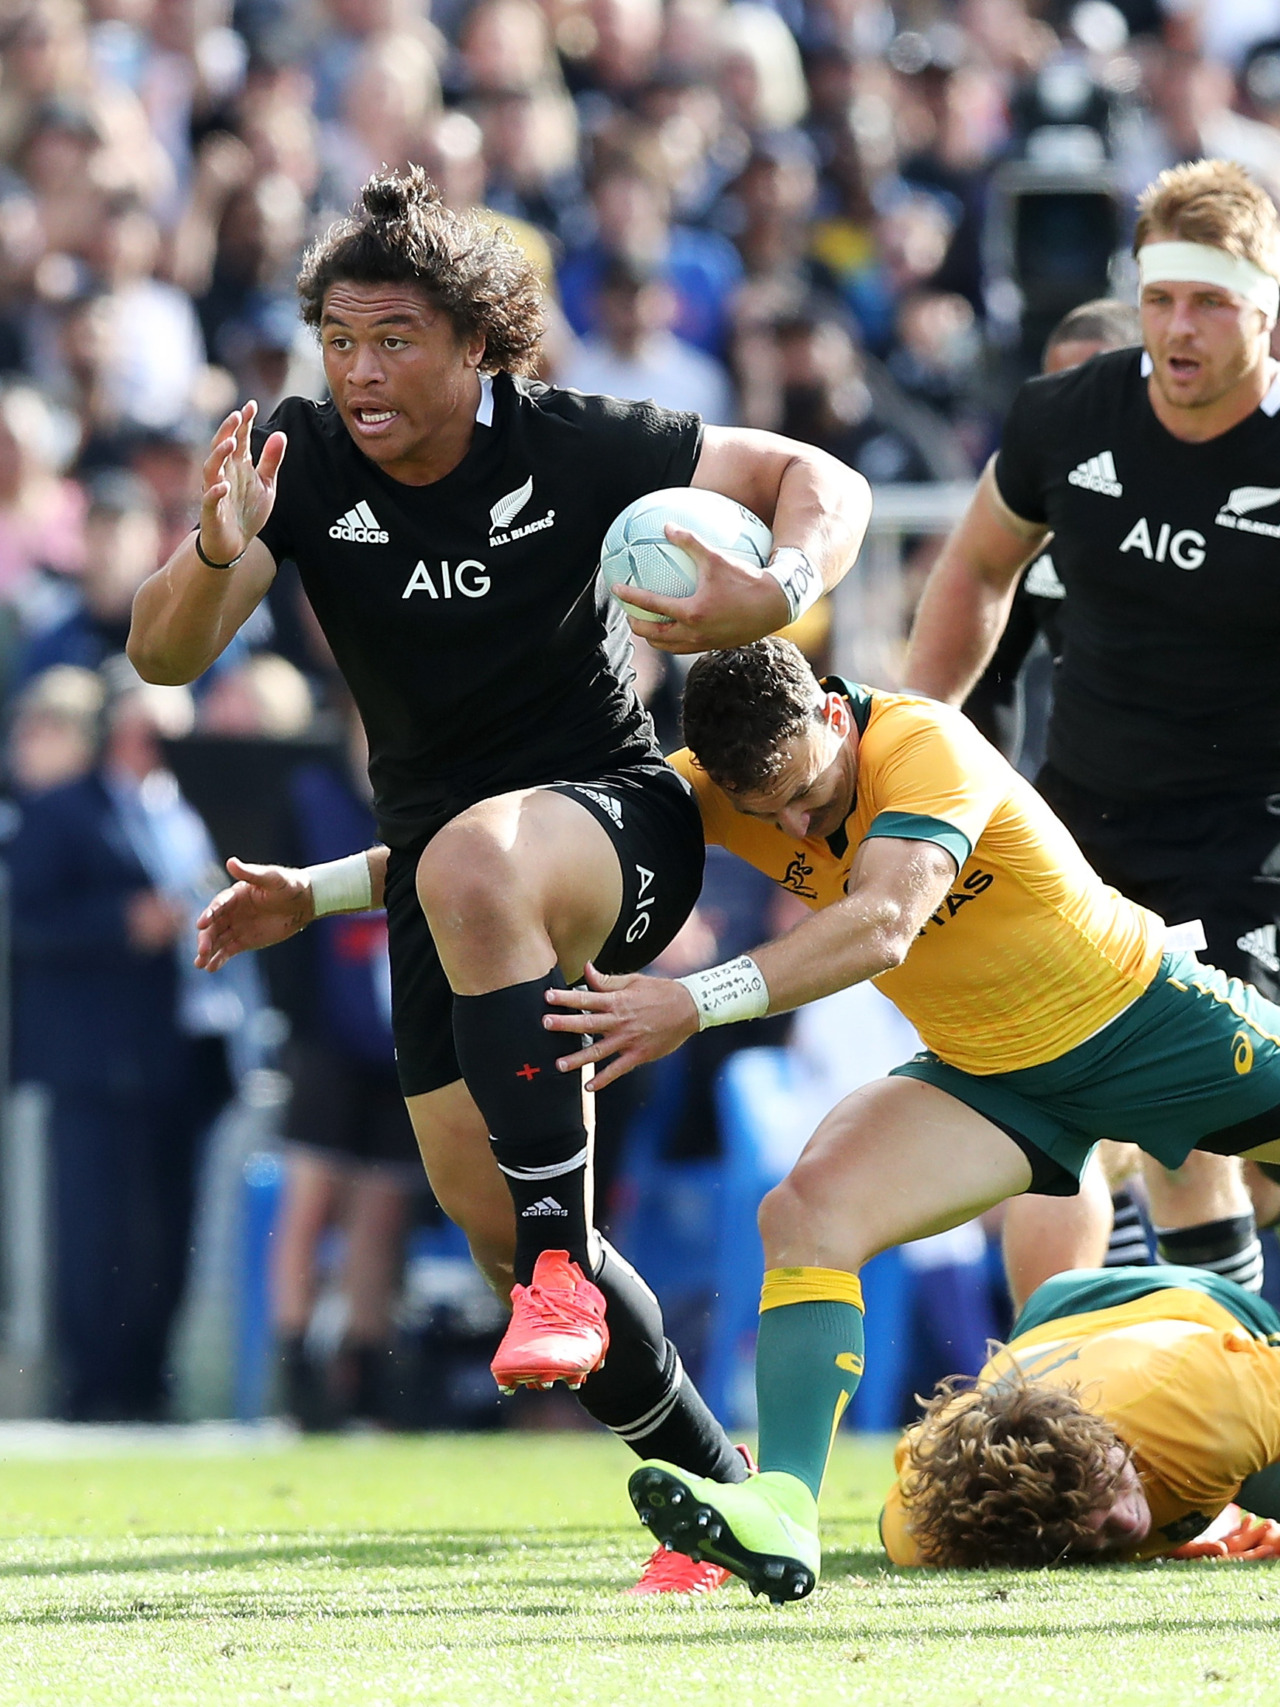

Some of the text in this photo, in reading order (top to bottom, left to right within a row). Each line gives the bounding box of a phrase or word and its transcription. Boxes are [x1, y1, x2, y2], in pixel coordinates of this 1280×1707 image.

[328, 525, 390, 544] adidas
[489, 517, 554, 547] ALL BLACKS
[1119, 516, 1206, 571] AIG
[401, 559, 491, 599] AIG
[574, 786, 625, 830] adidas
[625, 863, 656, 943] AIG
[521, 1209, 569, 1217] adidas
